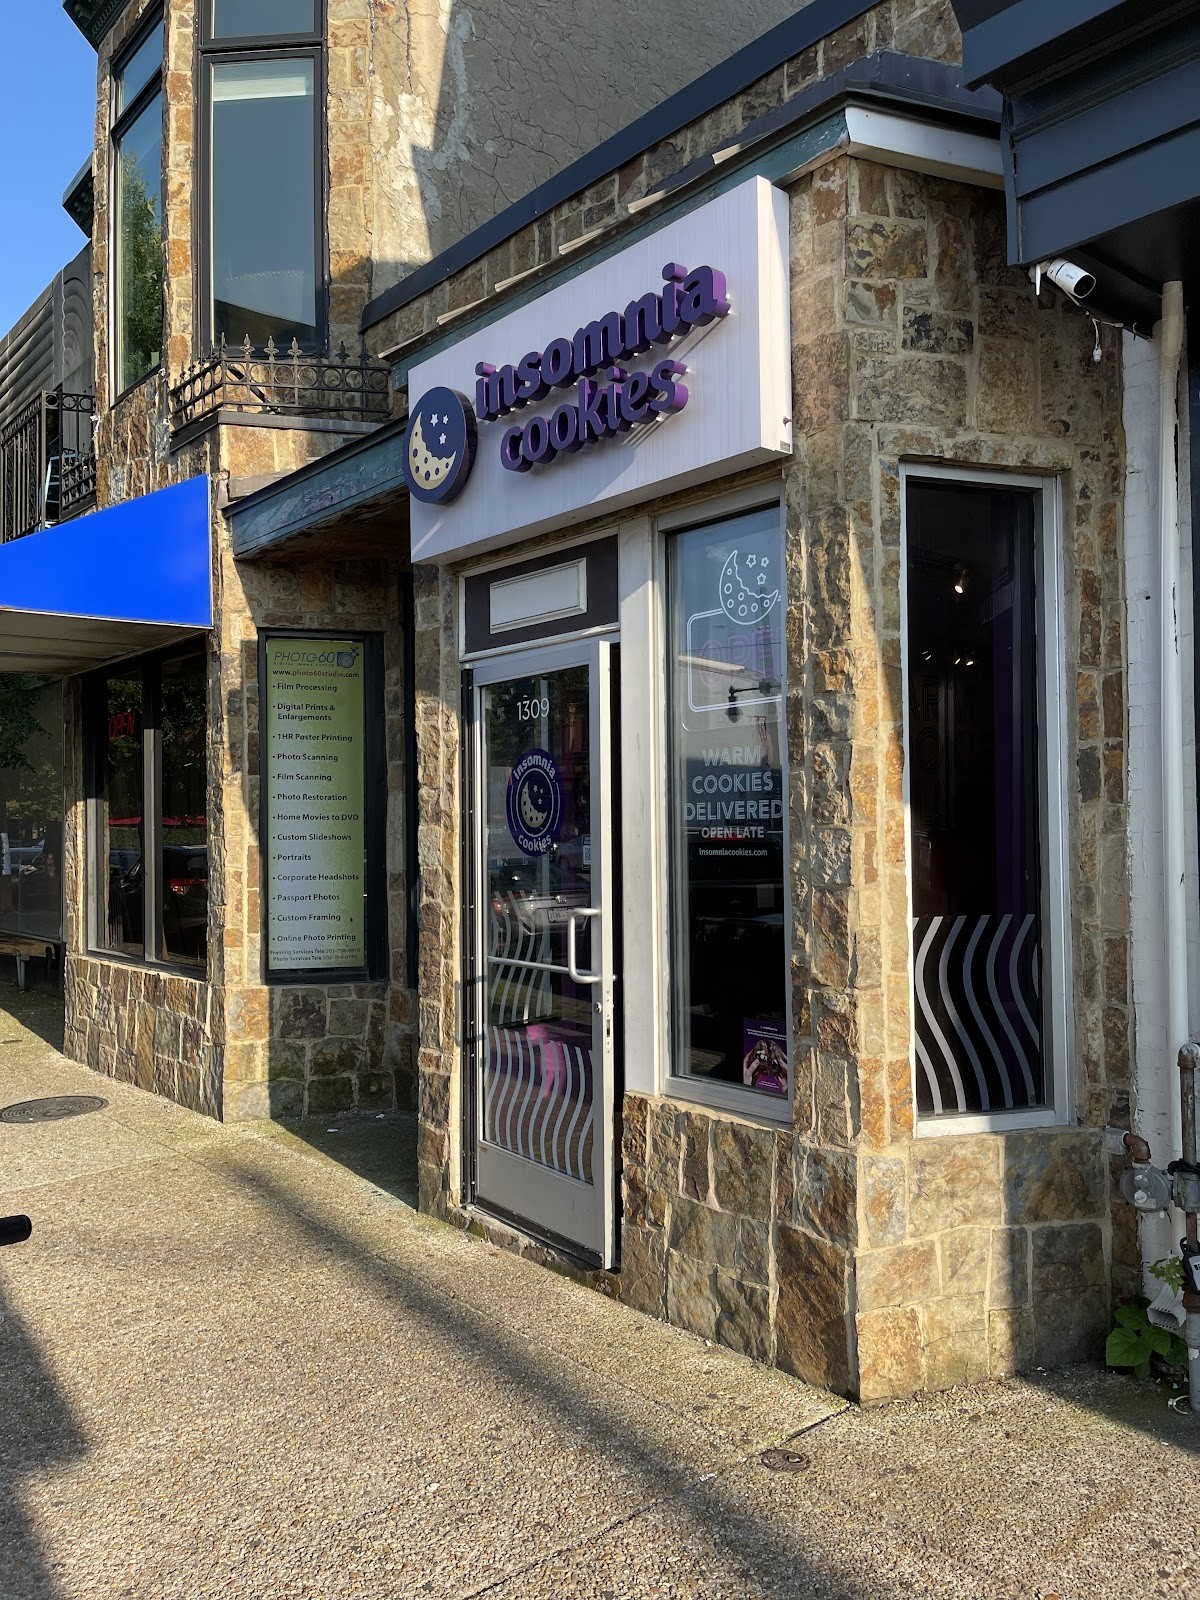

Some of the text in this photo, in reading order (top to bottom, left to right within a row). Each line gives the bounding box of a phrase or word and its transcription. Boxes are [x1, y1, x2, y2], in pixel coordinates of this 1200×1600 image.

[475, 262, 732, 421] insomnia
[500, 359, 689, 473] cookies
[272, 669, 360, 678] www.photo60studio.com
[295, 683, 338, 692] Processing
[277, 703, 304, 711] Digital
[516, 697, 550, 721] 1309
[277, 713, 332, 721] Enlargements
[108, 710, 136, 740] OPEN
[321, 734, 353, 742] Printing
[277, 753, 339, 762] Photo Scanning
[702, 744, 761, 767] WARM
[512, 754, 556, 781] insomnia
[295, 773, 332, 782] Scanning
[691, 771, 774, 795] COOKIES
[277, 793, 348, 801] Photo Restoration
[683, 799, 784, 821] DELIVERED
[277, 813, 301, 821] Home
[302, 813, 330, 821] Movies
[341, 813, 359, 821] DVD
[308, 833, 352, 841] Slideshows
[701, 826, 765, 839] OPEN LATE
[518, 834, 552, 853] cookies
[277, 853, 312, 861] Portraits
[277, 873, 359, 882] Corporate Headshots
[277, 893, 340, 903] Passport Photos
[277, 913, 341, 922] Custom Framing
[277, 934, 302, 942] Online
[326, 933, 357, 942] Printing
